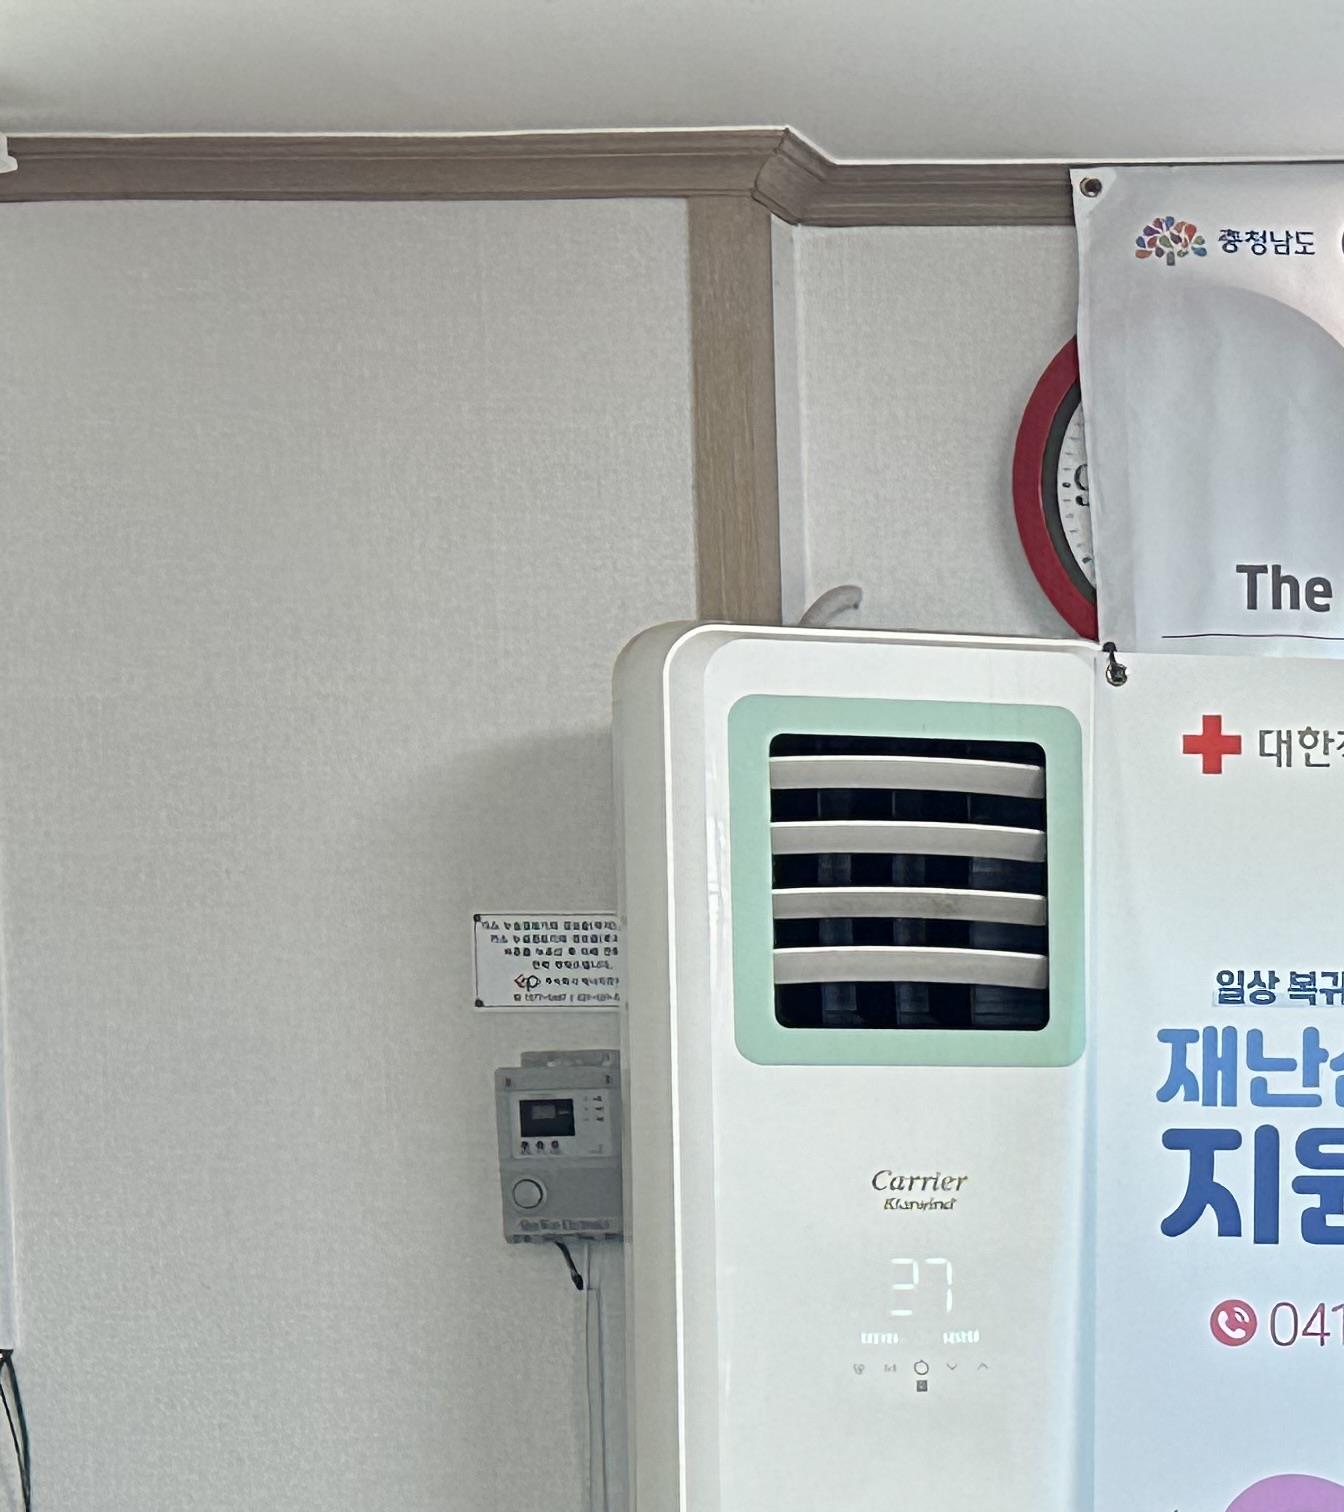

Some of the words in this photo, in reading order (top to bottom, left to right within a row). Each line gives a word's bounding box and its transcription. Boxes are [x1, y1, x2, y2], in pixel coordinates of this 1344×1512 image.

[1218, 229, 1315, 256] 충청남도
[1236, 563, 1332, 612] The
[1216, 970, 1279, 1006] 일상
[872, 1169, 968, 1192] Carrier
[890, 1257, 953, 1316] 27
